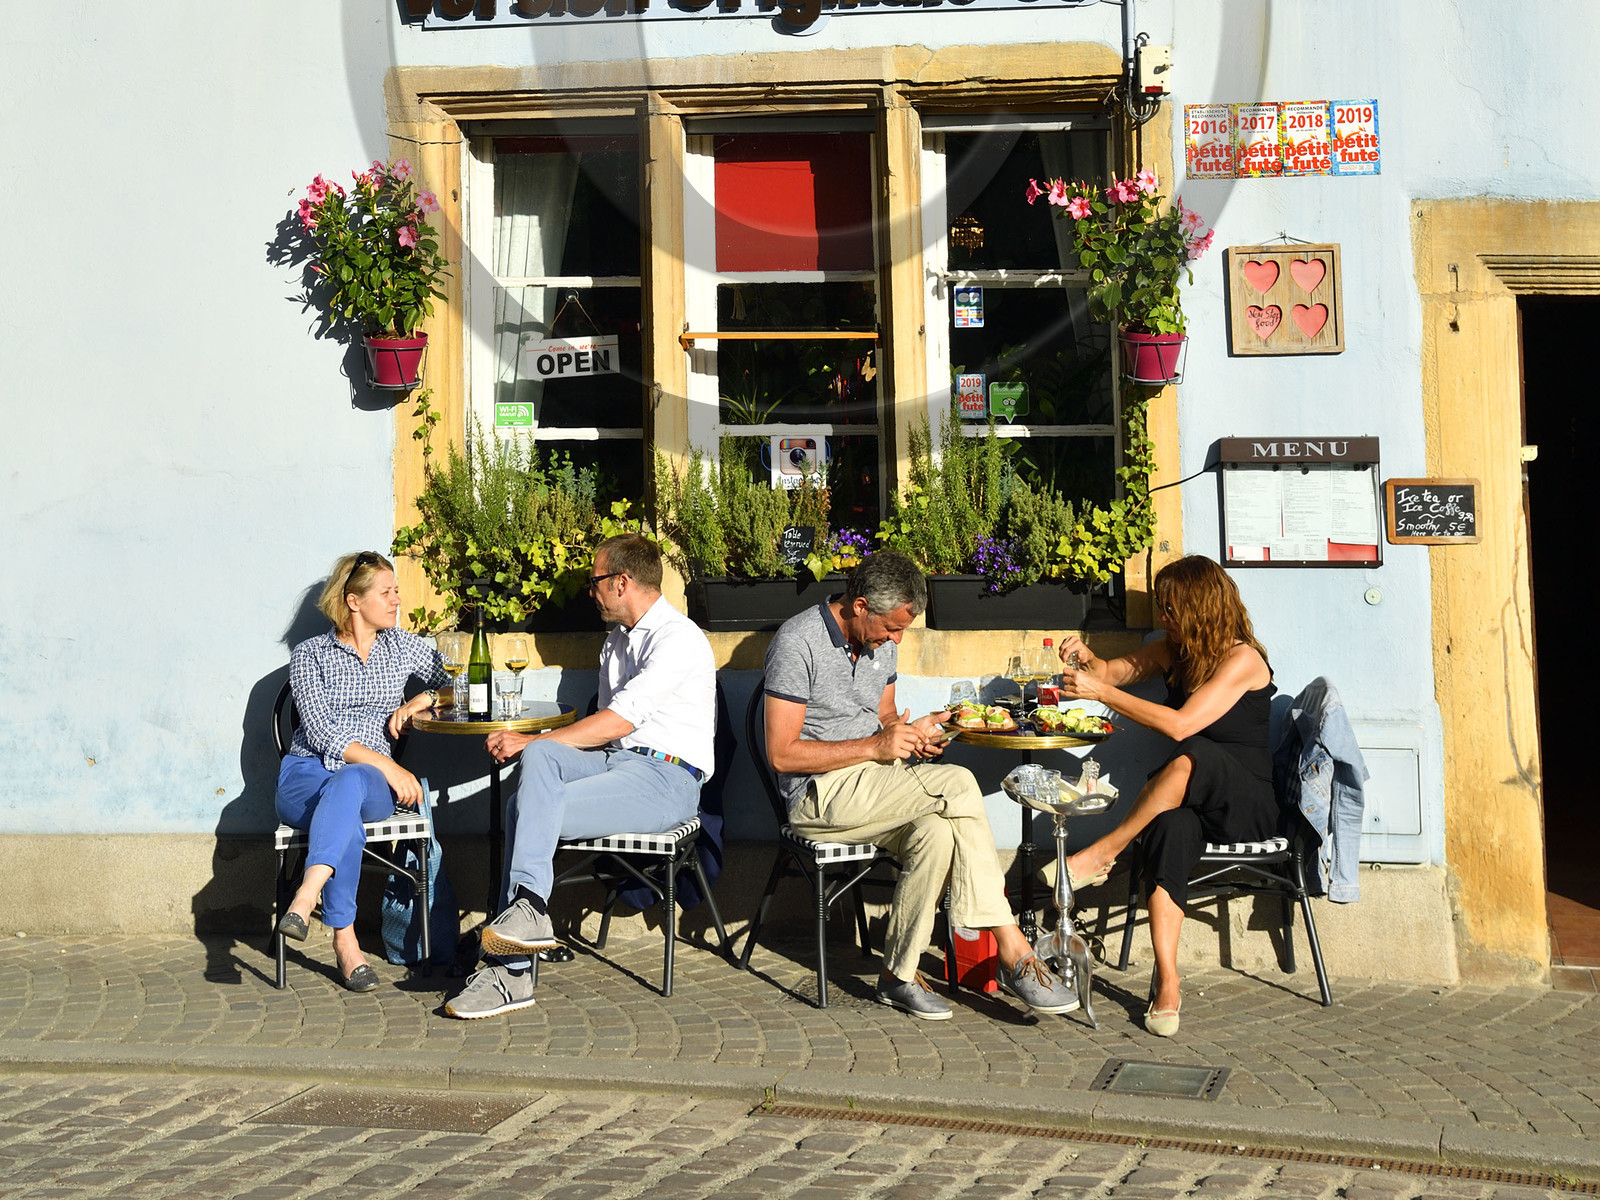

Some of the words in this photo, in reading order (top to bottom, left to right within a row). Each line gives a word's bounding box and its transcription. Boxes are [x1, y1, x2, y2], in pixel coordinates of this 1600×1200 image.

[1241, 116, 1275, 130] 2017
[1288, 114, 1323, 129] 2018
[1336, 107, 1372, 124] 2019
[1191, 120, 1228, 134] 2016
[1332, 133, 1378, 152] petit
[1187, 144, 1233, 162] petit
[1236, 143, 1282, 162] petit
[1284, 141, 1330, 160] petit
[1195, 157, 1234, 172] futé
[1243, 157, 1283, 171] futé
[1292, 155, 1331, 170] futé
[536, 349, 611, 375] OPEN
[960, 377, 981, 388] 2019
[958, 393, 984, 404] petit
[1251, 441, 1349, 458] MENU
[1397, 488, 1420, 504] Ice
[1421, 489, 1441, 503] tea
[1447, 494, 1464, 503] or
[1401, 502, 1423, 513] Ice
[1396, 518, 1440, 531] Smoothy
